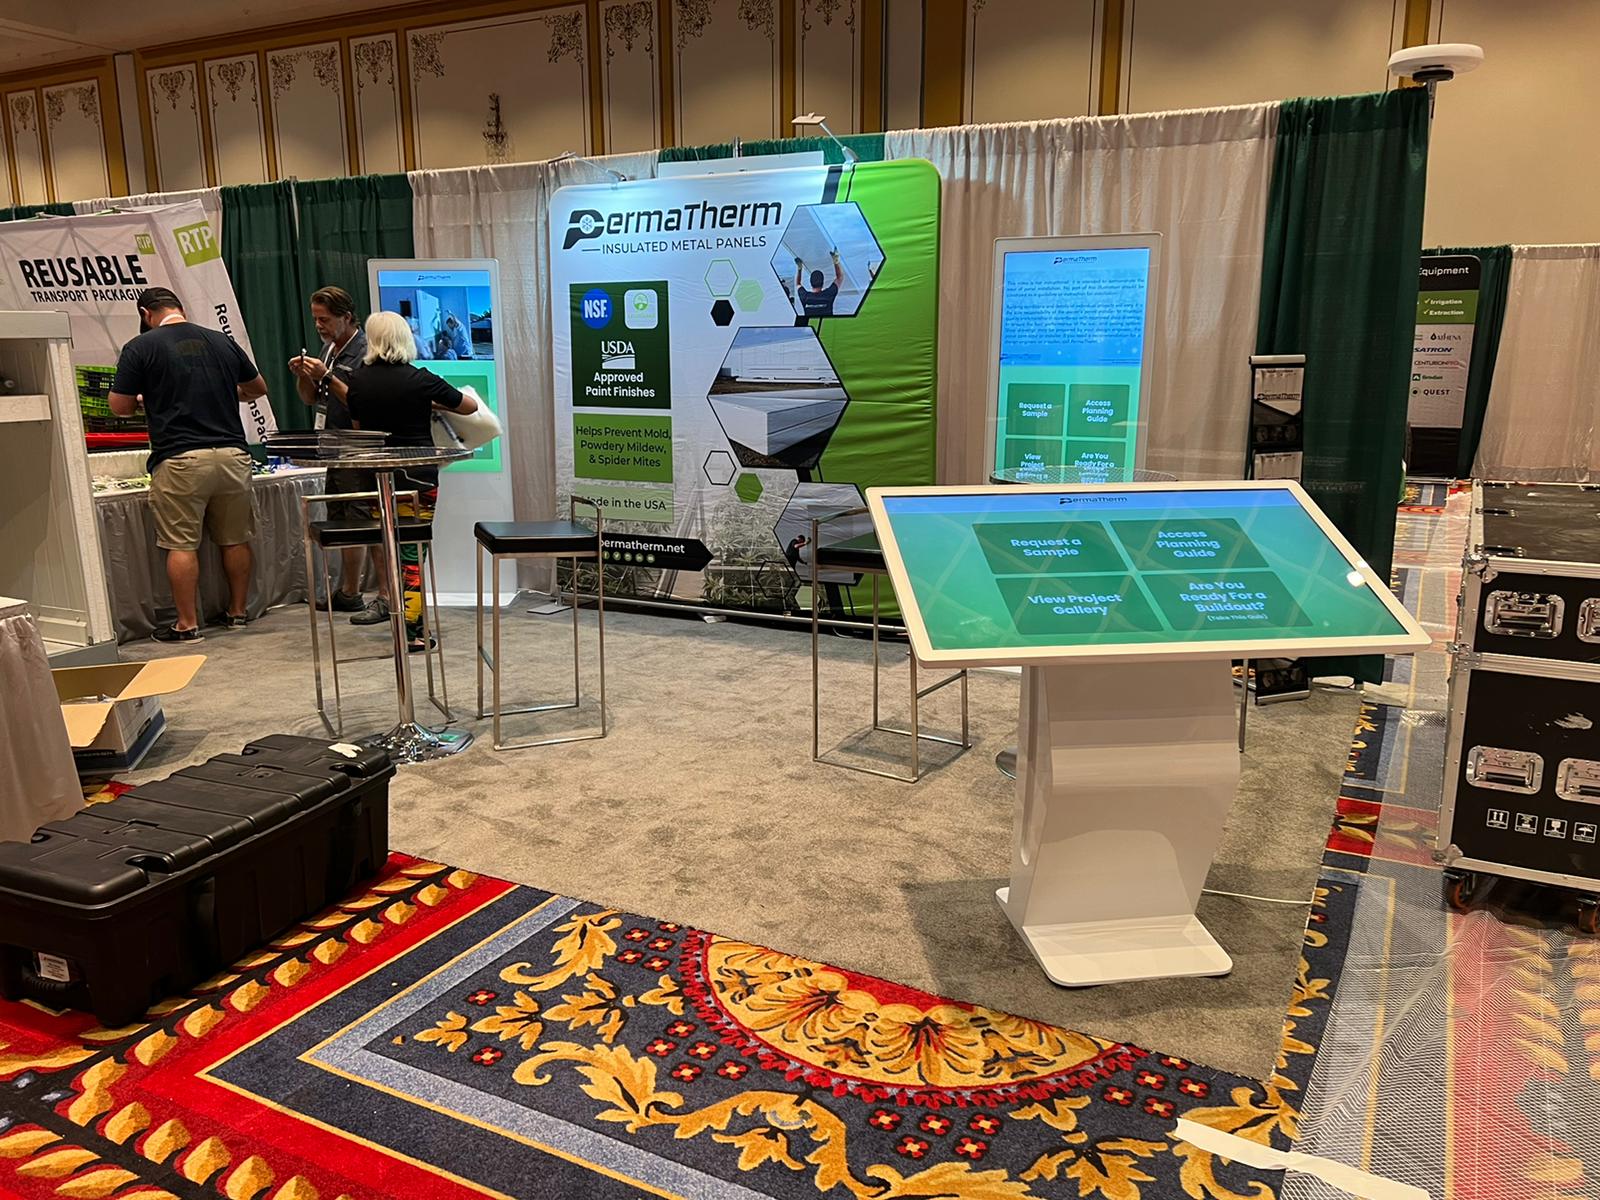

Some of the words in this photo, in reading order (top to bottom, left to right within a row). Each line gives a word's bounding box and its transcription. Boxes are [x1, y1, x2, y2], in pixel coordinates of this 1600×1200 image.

[136, 236, 151, 249] RTP
[178, 226, 212, 254] RTP
[602, 241, 668, 254] INSULATED
[671, 239, 712, 252] METAL
[716, 235, 767, 249] PANELS
[19, 255, 148, 288] REUSABLE
[31, 290, 88, 303] TRANSPORT
[92, 288, 146, 301] PACKAGIN
[584, 299, 607, 319] NSF
[601, 340, 635, 354] USDA
[593, 372, 643, 384] Approved
[585, 386, 611, 397] Paint
[613, 386, 655, 398] Finishes
[1018, 402, 1047, 411] Request
[1082, 408, 1113, 416] Planning
[1022, 410, 1048, 418] Sample
[576, 426, 602, 437] Helps
[604, 427, 642, 438] Prevent
[644, 428, 671, 440] Mold,
[580, 440, 625, 453] Powdery
[627, 441, 667, 454] Mildew,
[589, 455, 596, 464] &
[598, 455, 630, 467] Spider
[633, 456, 661, 467] Mites
[1075, 460, 1096, 468] Ready
[611, 497, 621, 507] in
[624, 499, 641, 509] the
[644, 500, 667, 510] USA
[1010, 538, 1070, 548] Request
[1156, 540, 1220, 549] Planning
[1023, 548, 1079, 557] Sample
[1173, 549, 1216, 557] Guide
[1189, 582, 1214, 590] Are
[1214, 581, 1245, 589] You
[1027, 595, 1065, 604] View
[1067, 593, 1122, 604] Project
[1180, 592, 1227, 602] Ready
[1228, 592, 1253, 600] For
[1053, 605, 1107, 615] Gallery
[1194, 602, 1264, 612] Buildout?
